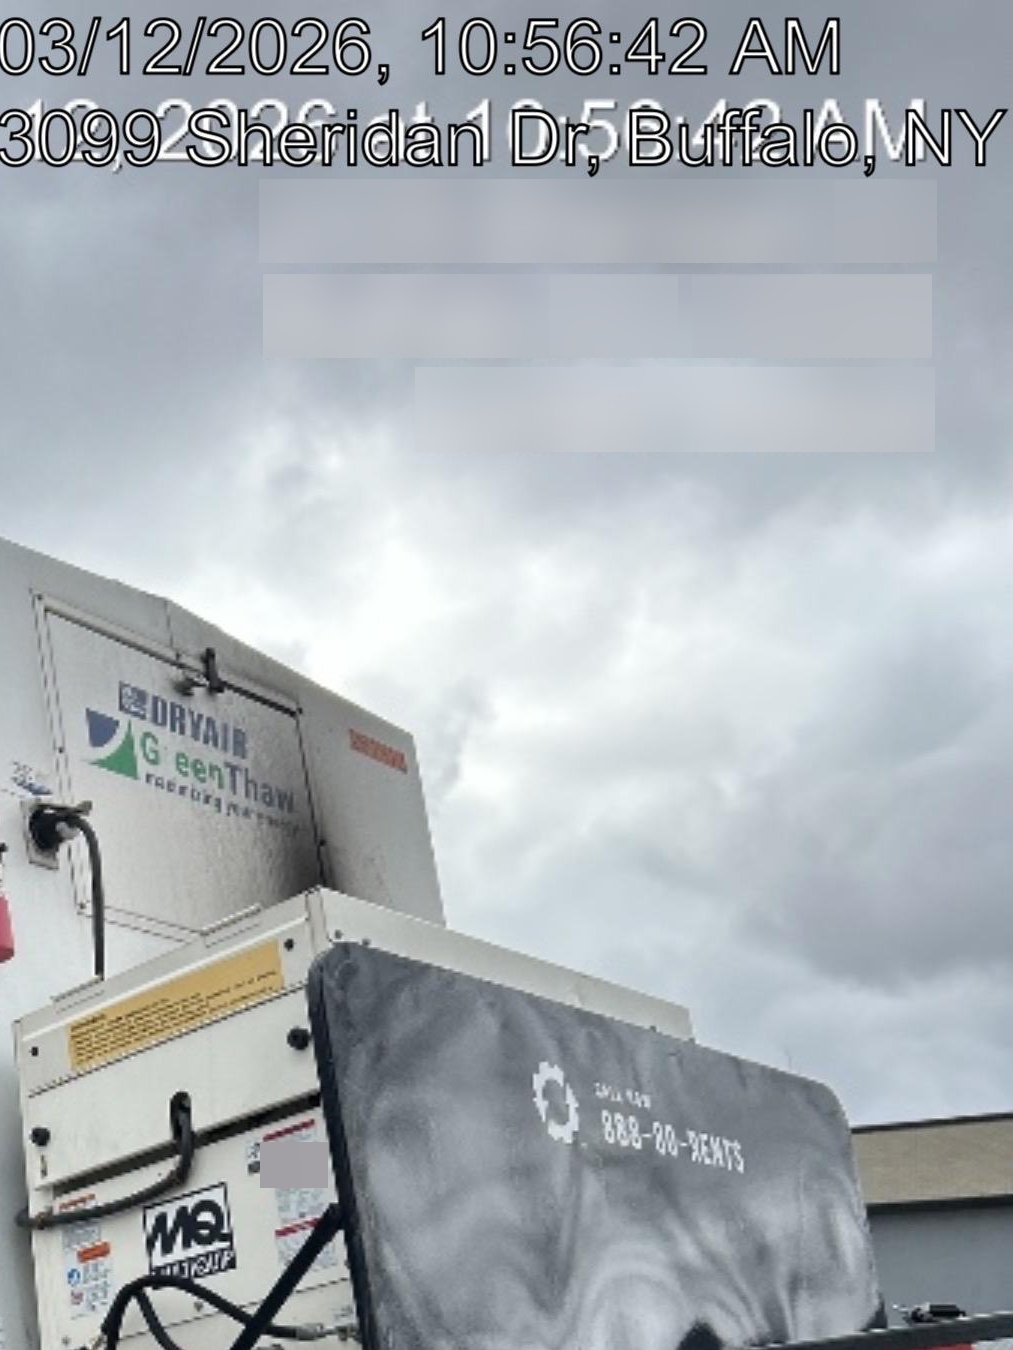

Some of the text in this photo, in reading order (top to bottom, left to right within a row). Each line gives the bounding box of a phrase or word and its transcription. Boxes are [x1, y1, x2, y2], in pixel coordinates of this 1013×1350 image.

[152, 694, 248, 760] DRYAIR
[140, 731, 295, 814] GeenThaw
[146, 1199, 233, 1257] MQ
